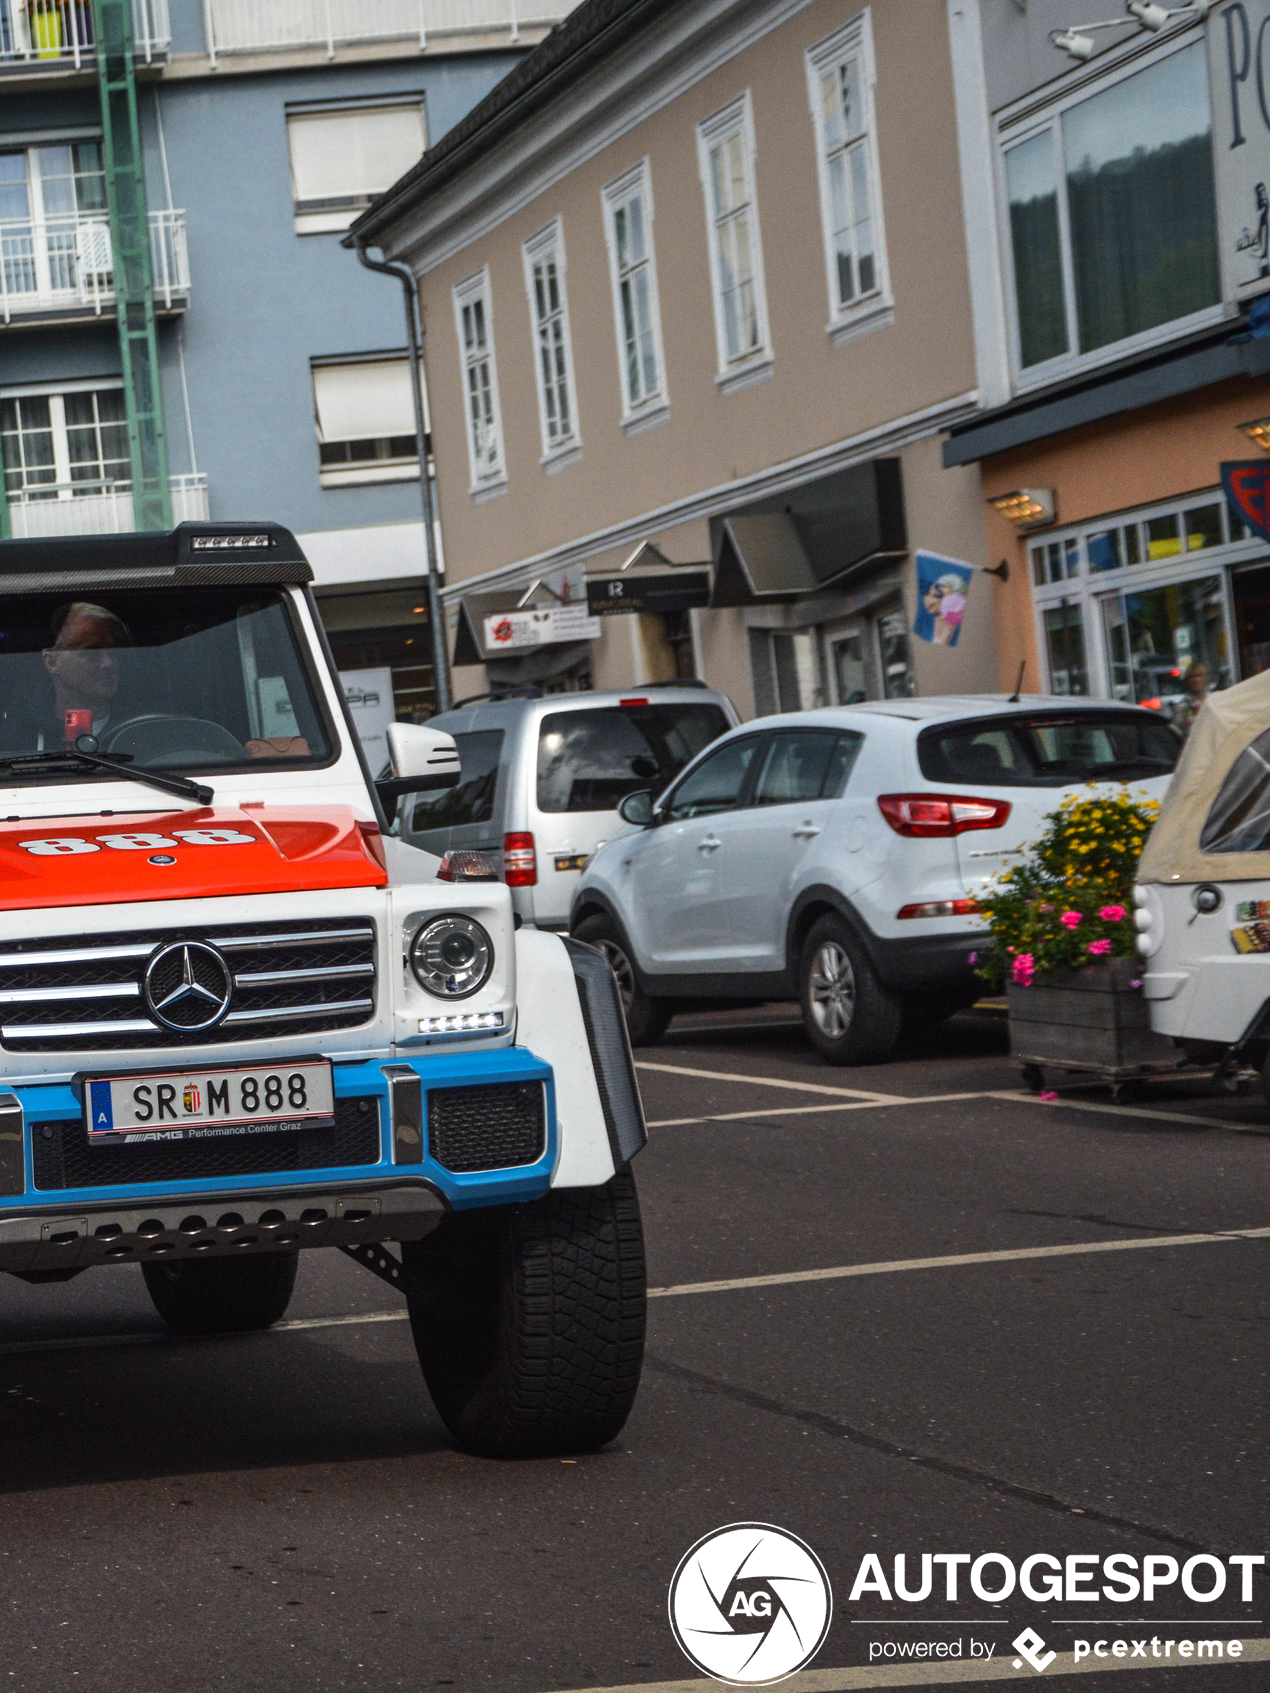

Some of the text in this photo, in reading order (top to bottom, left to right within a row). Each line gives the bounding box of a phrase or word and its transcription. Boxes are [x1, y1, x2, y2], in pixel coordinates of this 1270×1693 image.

[17, 829, 258, 856] 888
[133, 1072, 308, 1121] SR M 888
[98, 1112, 107, 1124] A
[189, 1127, 245, 1138] Performance
[248, 1124, 278, 1134] Center
[280, 1122, 302, 1132] Graz
